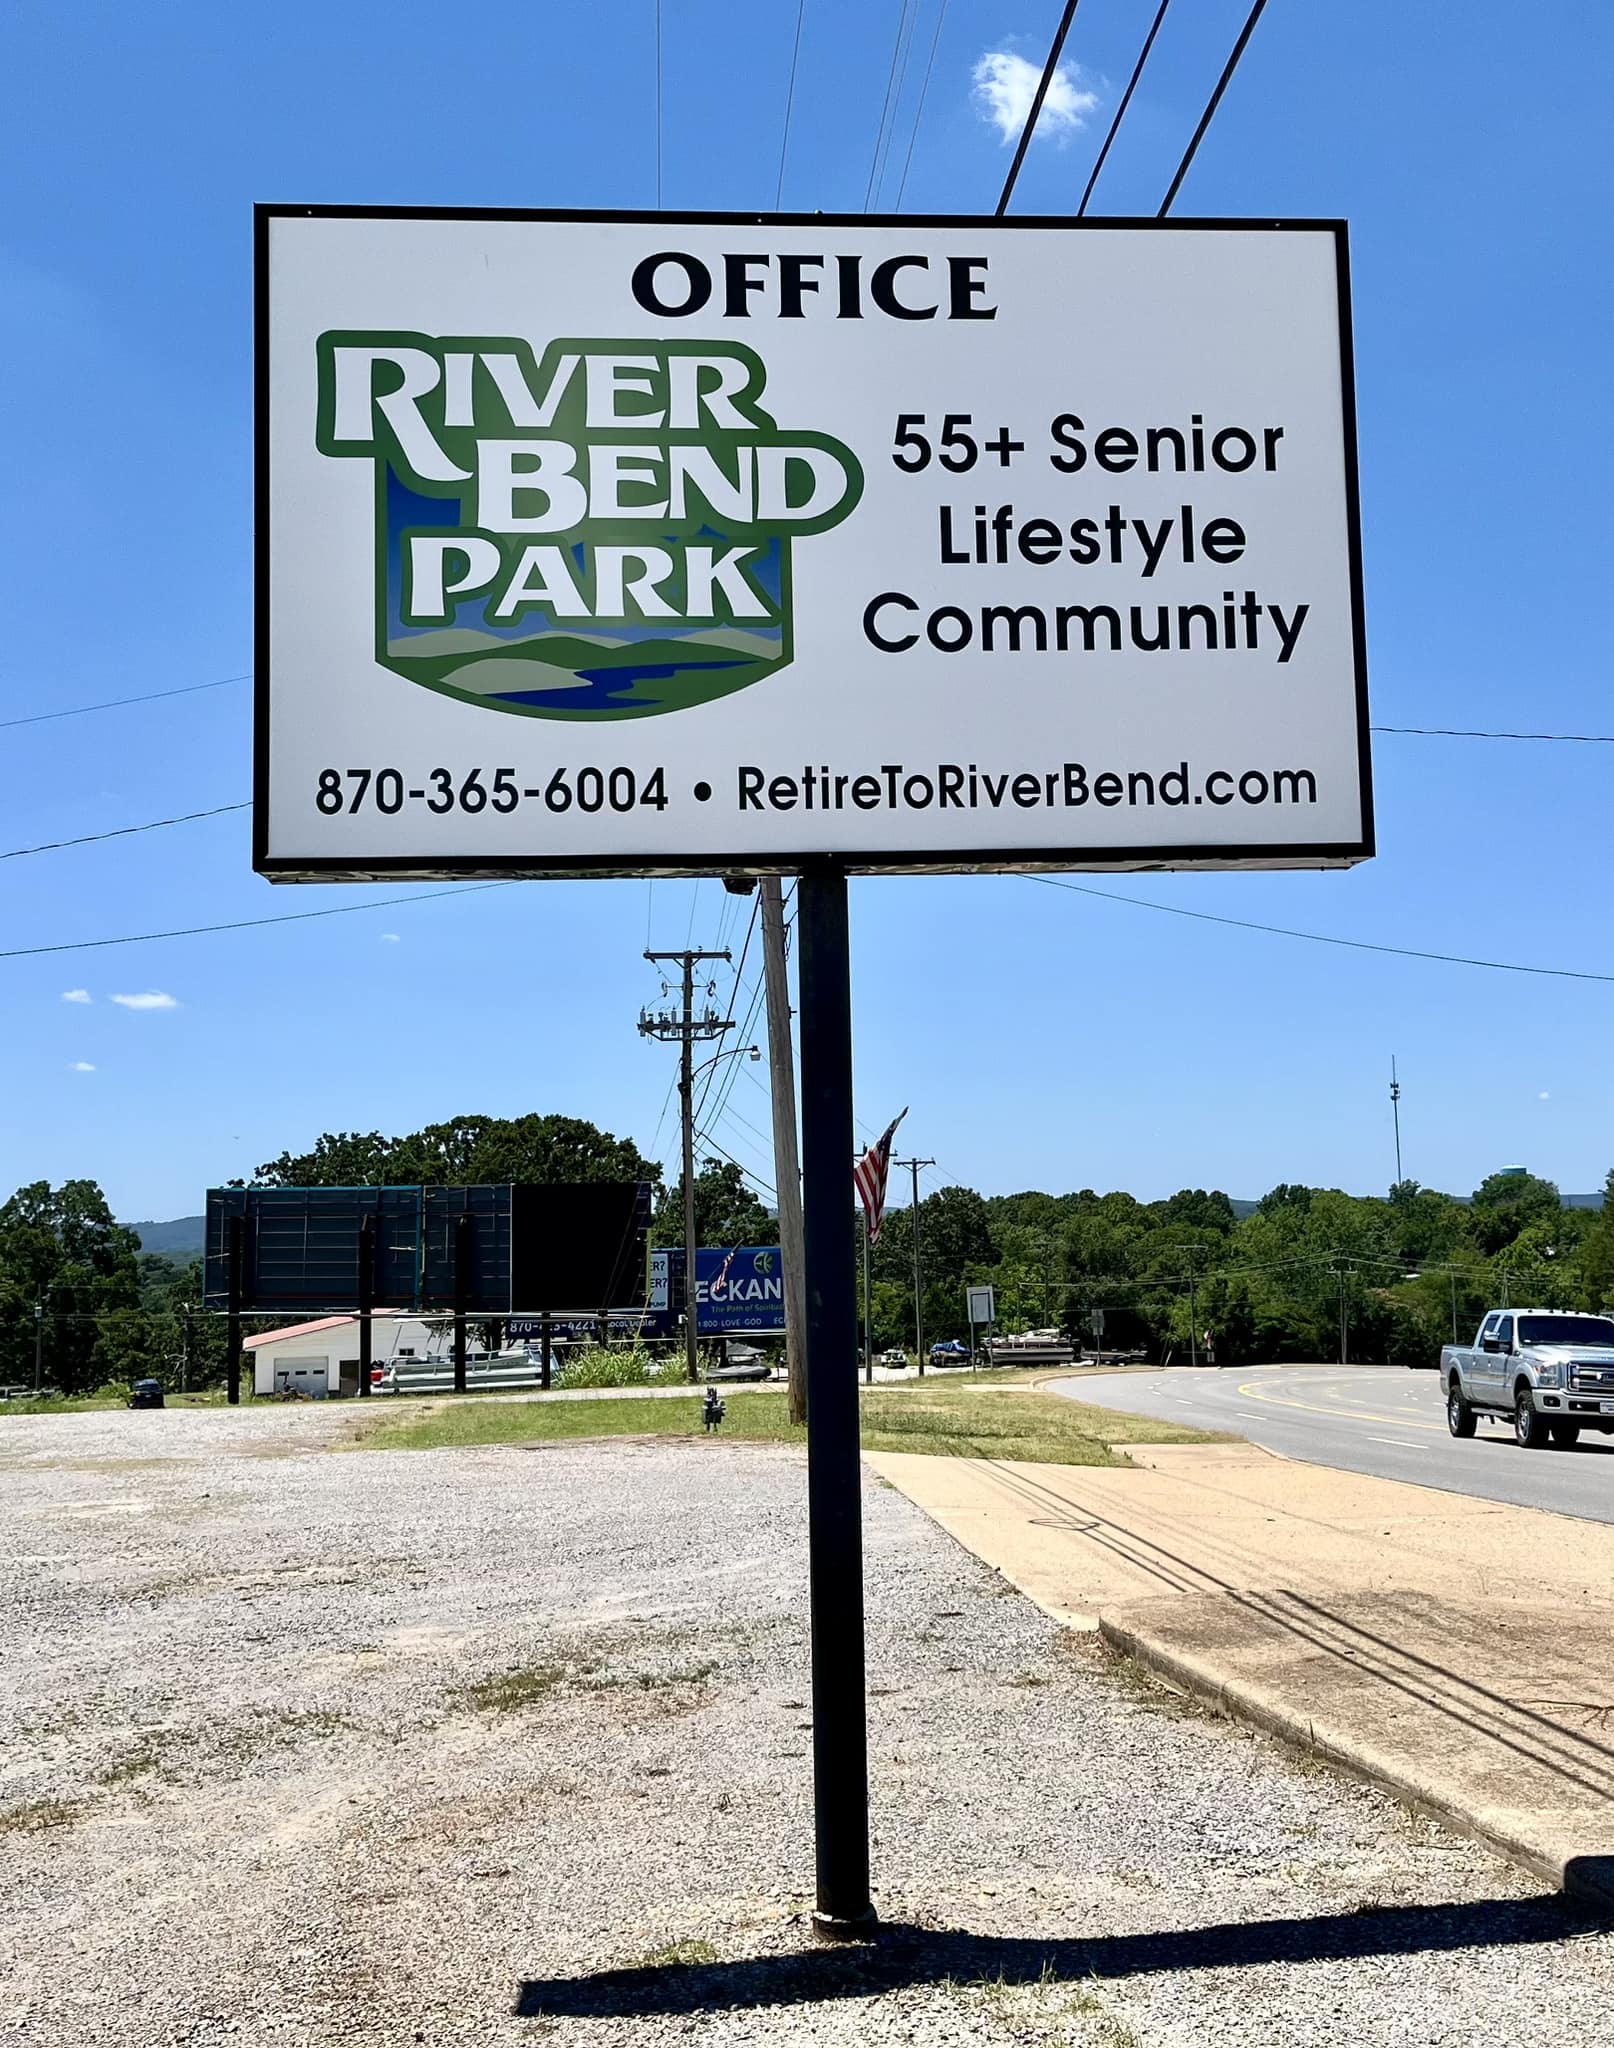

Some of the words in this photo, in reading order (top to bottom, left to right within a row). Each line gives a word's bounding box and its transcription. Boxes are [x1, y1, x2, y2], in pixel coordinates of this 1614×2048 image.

[632, 251, 998, 321] OFFICE
[333, 347, 760, 481] RIVER
[891, 413, 1025, 474] 55+
[1049, 413, 1284, 474] Senior
[477, 440, 848, 534] BEND
[410, 537, 772, 617] PARK
[939, 504, 1246, 578] Lifestyle
[862, 590, 1310, 663] Community
[315, 766, 669, 816] 870-365-6004
[738, 761, 1317, 811] RetireToRiverBend.com
[695, 1278, 782, 1303] ECKAN
